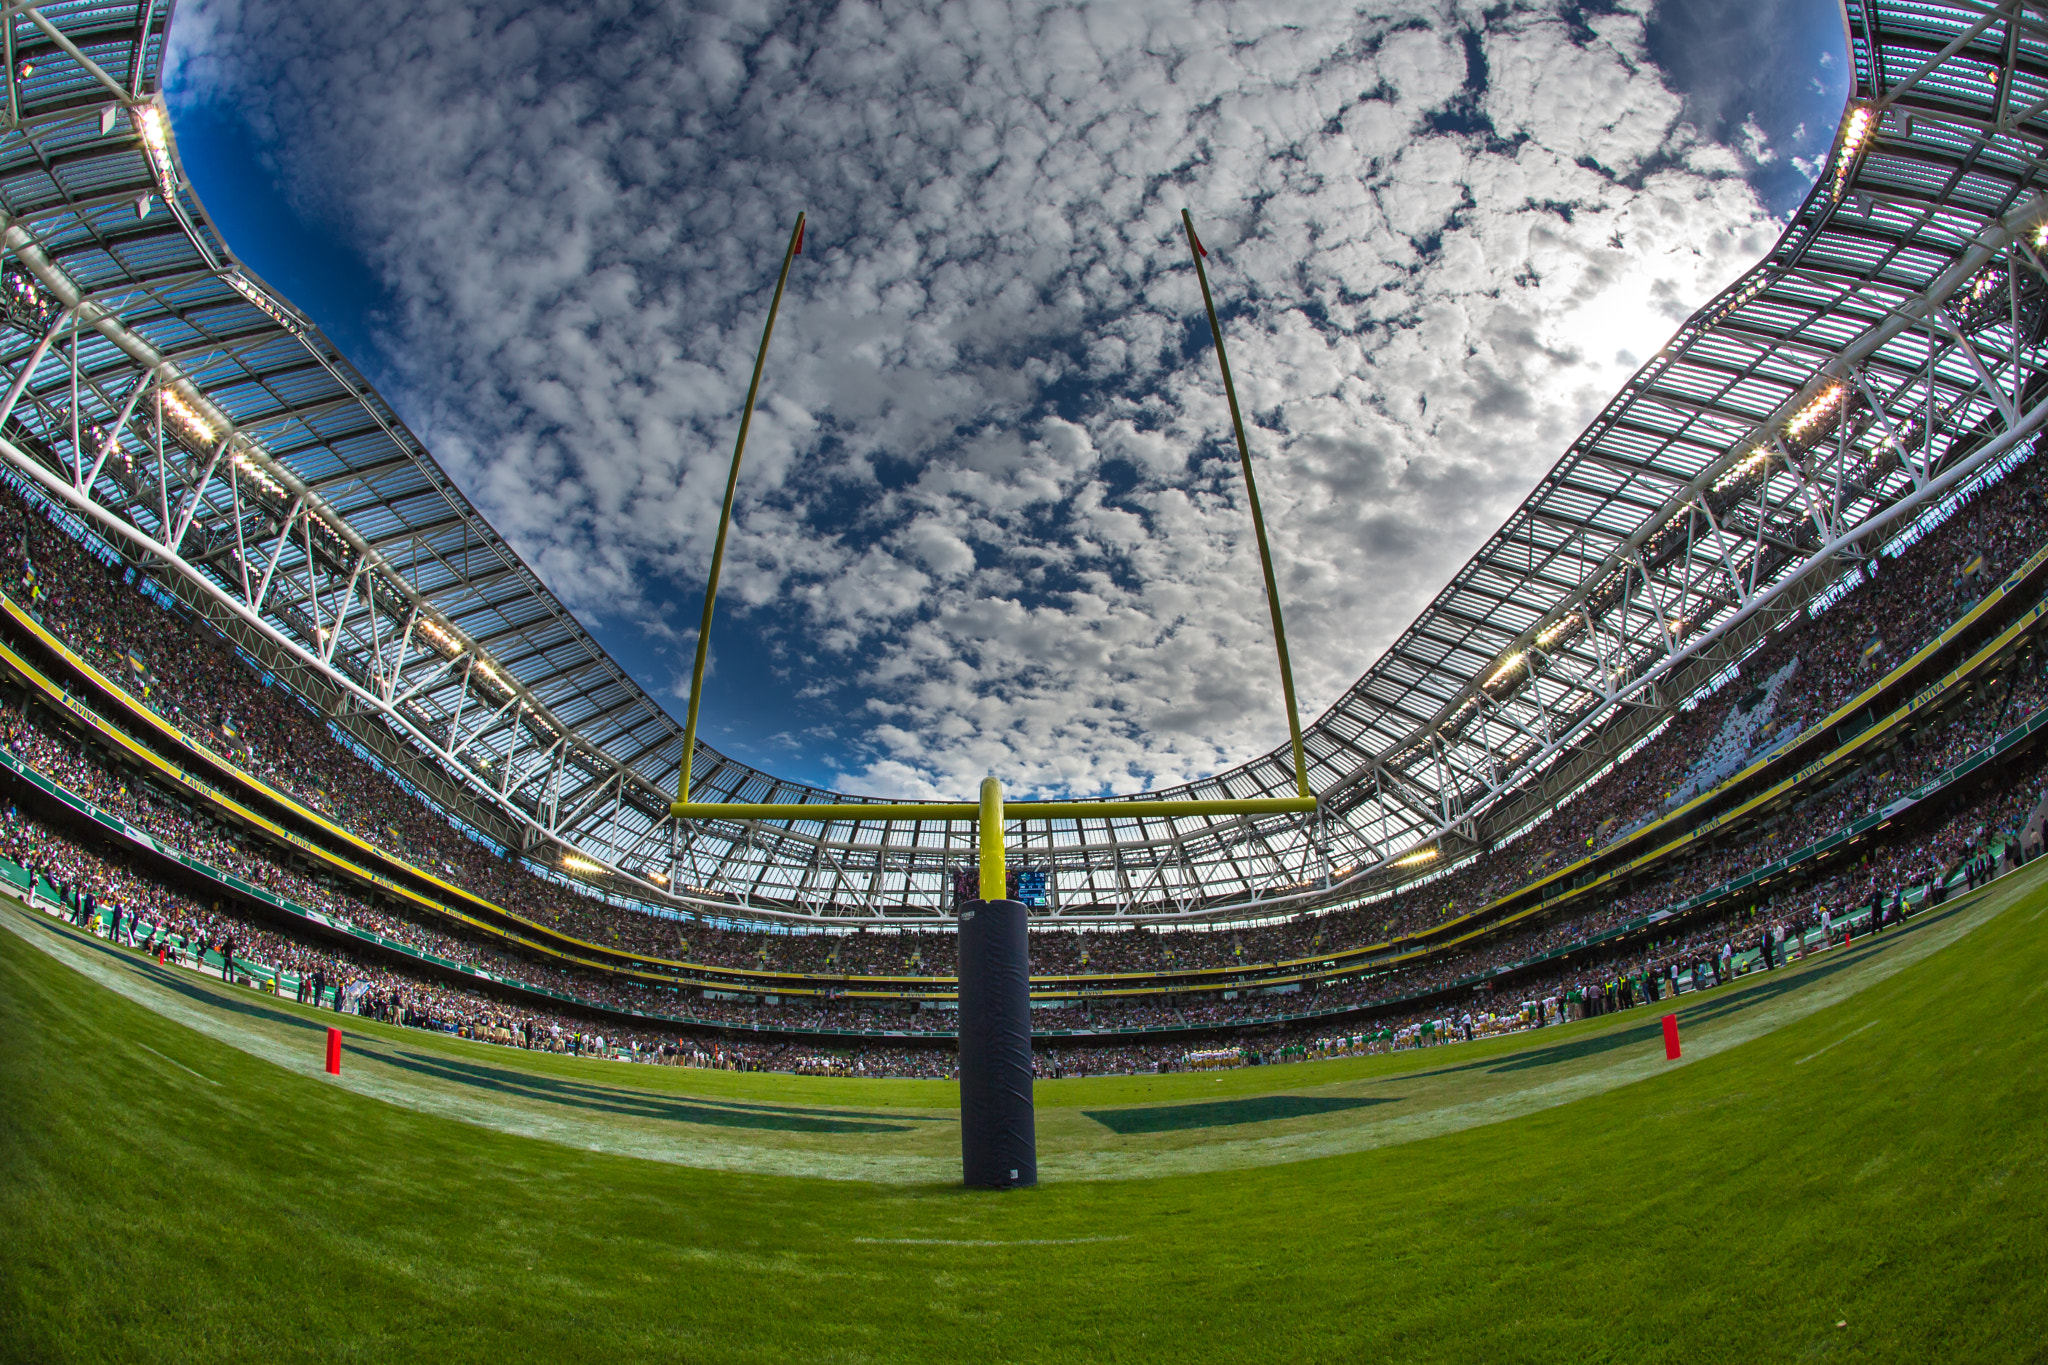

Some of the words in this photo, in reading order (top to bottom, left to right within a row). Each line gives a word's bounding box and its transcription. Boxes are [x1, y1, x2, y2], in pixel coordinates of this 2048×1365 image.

[1918, 682, 1945, 706] AVIVA
[70, 701, 98, 726] AVIVA
[1801, 760, 1826, 779] AVIVA
[187, 778, 212, 797] AVIVA
[1921, 780, 1941, 795] SPACES
[1699, 819, 1721, 835] AVIVA
[291, 835, 311, 850] AVIVA
[1615, 863, 1633, 877] AVIVA
[377, 877, 394, 890] AVIVA
